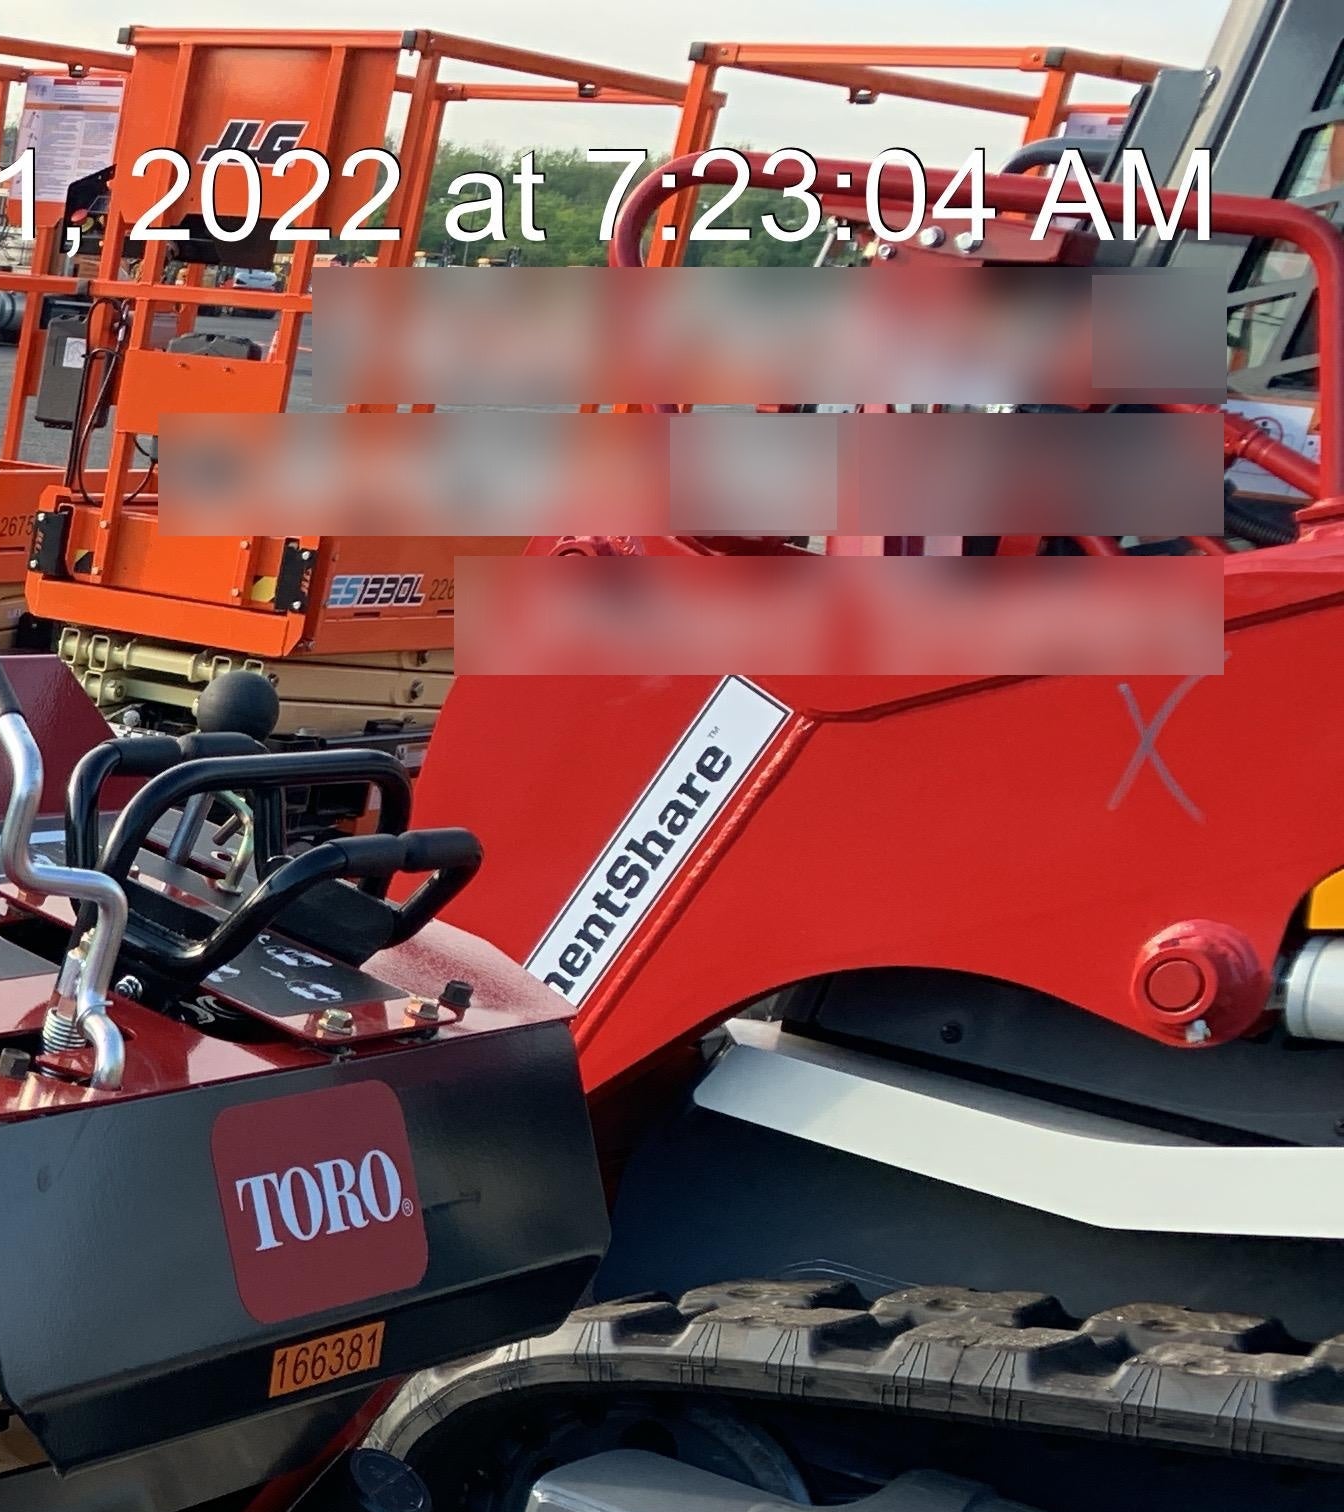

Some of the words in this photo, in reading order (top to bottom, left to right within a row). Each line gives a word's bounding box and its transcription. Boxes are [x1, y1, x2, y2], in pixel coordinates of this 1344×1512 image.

[196, 118, 310, 168] JLG
[327, 573, 426, 608] ES1330L
[235, 1147, 405, 1252] TORO
[275, 1327, 380, 1393] 166381
